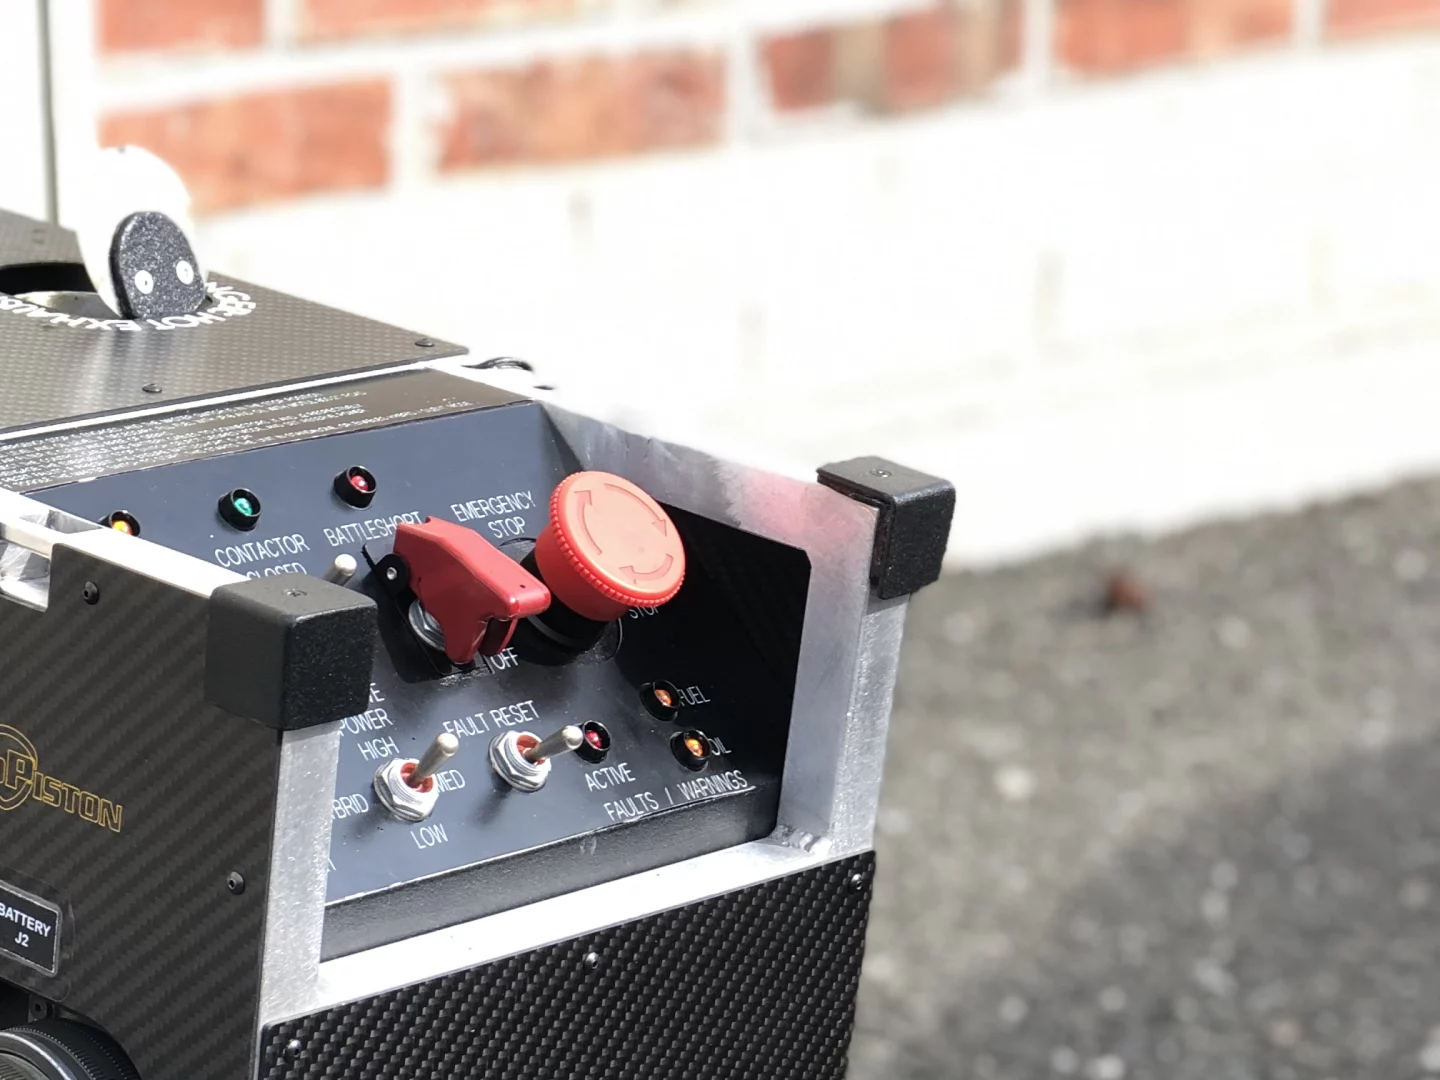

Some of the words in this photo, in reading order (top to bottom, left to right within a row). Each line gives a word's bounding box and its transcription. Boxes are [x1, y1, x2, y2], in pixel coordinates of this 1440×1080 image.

[450, 490, 538, 523] EMERGENCY
[487, 516, 526, 540] STOP
[214, 532, 311, 568] CONTACTOR
[494, 646, 519, 671] OFF
[443, 712, 491, 738] FAULT
[489, 700, 540, 729] RESET
[357, 736, 400, 761] HIGH
[434, 769, 466, 794] MED
[584, 762, 636, 792] ACTIVE
[333, 793, 369, 820] BRID
[603, 791, 660, 822] FAULTS
[676, 770, 748, 801] WARNINGS
[410, 823, 449, 850] LOW
[14, 932, 30, 948] J2
